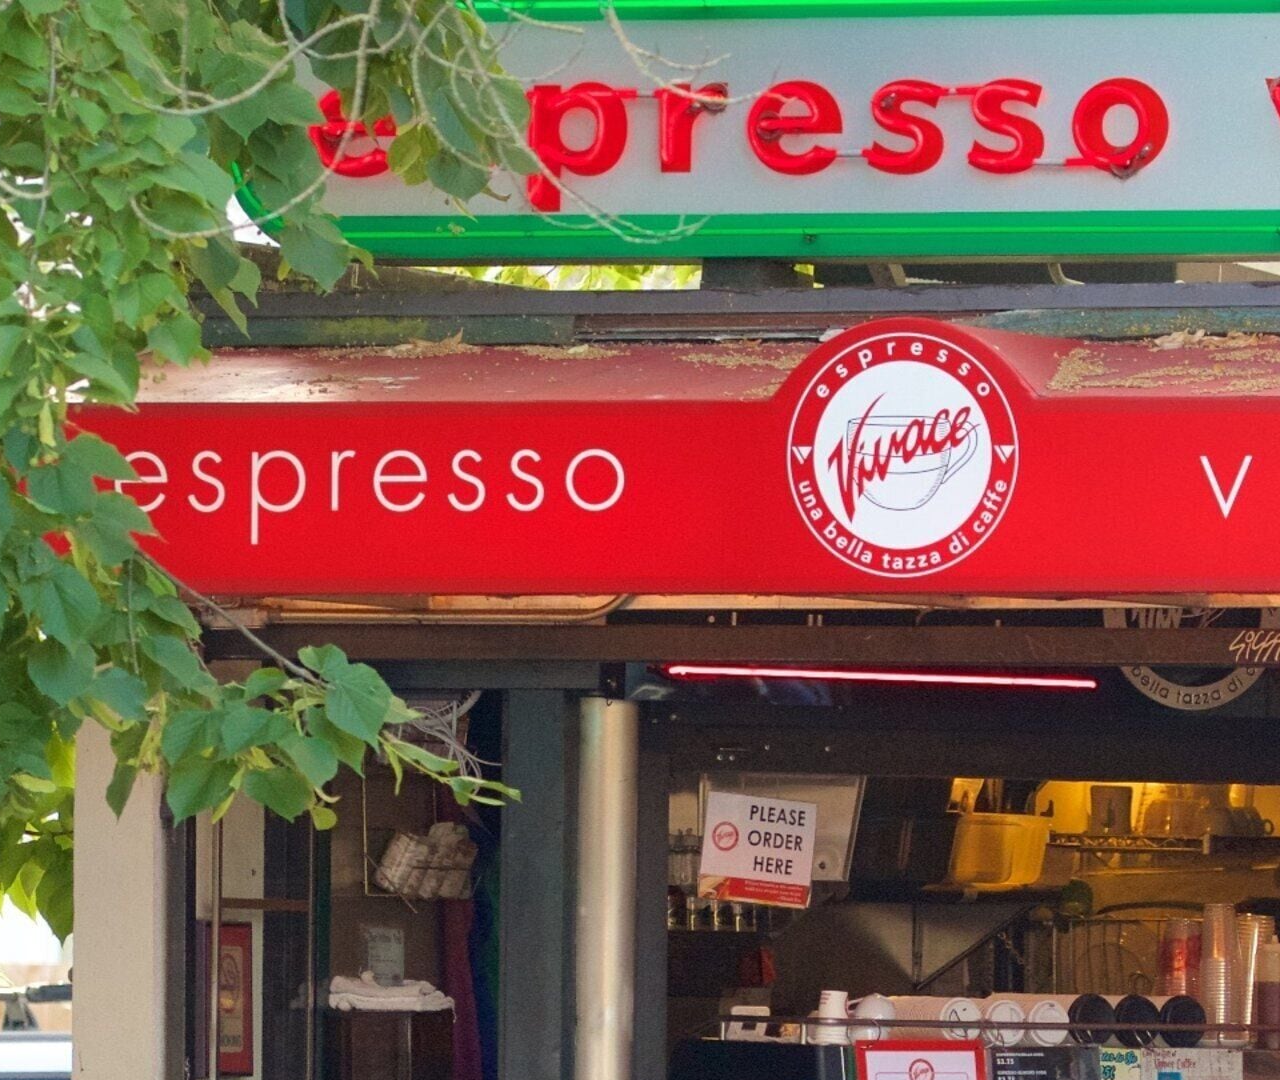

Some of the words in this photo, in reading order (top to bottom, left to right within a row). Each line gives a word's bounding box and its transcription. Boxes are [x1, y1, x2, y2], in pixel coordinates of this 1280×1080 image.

[307, 78, 1169, 213] epresso
[816, 341, 990, 398] espresso
[828, 391, 981, 524] Vivace
[114, 447, 626, 545] espresso
[798, 480, 823, 521] una
[823, 521, 873, 563] bella
[882, 550, 942, 571] tazza
[948, 531, 969, 555] di
[972, 479, 1008, 533] caffe
[1175, 688, 1222, 706] tazza
[1227, 674, 1243, 694] di
[747, 830, 803, 852] ORDER
[749, 804, 806, 827] PLEASE
[753, 856, 793, 875] HERE
